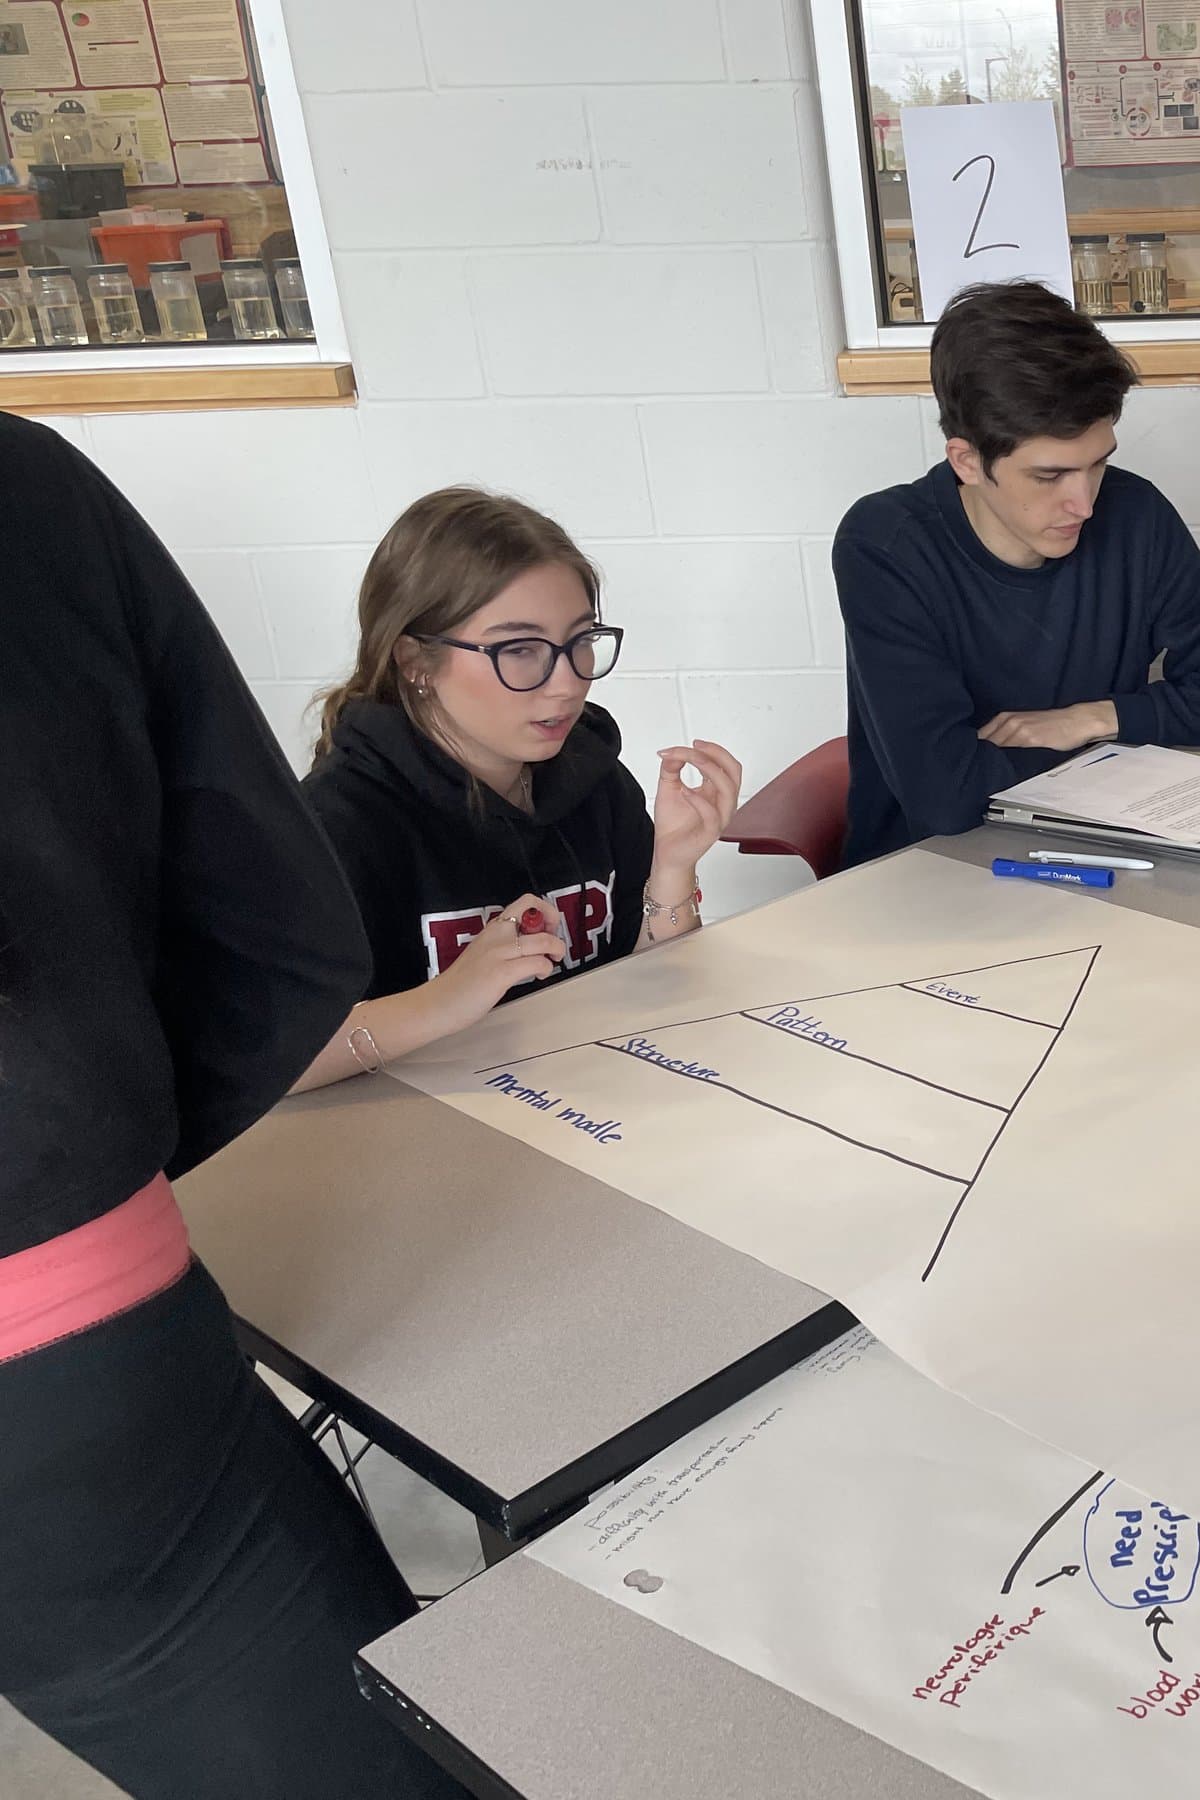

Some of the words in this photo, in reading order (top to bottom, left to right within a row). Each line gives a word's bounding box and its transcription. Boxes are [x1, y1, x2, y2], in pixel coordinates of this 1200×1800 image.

[952, 154, 1020, 259] 2
[766, 1006, 848, 1050] Pattern
[620, 1037, 720, 1078] Structure
[1116, 1670, 1181, 1719] blood
